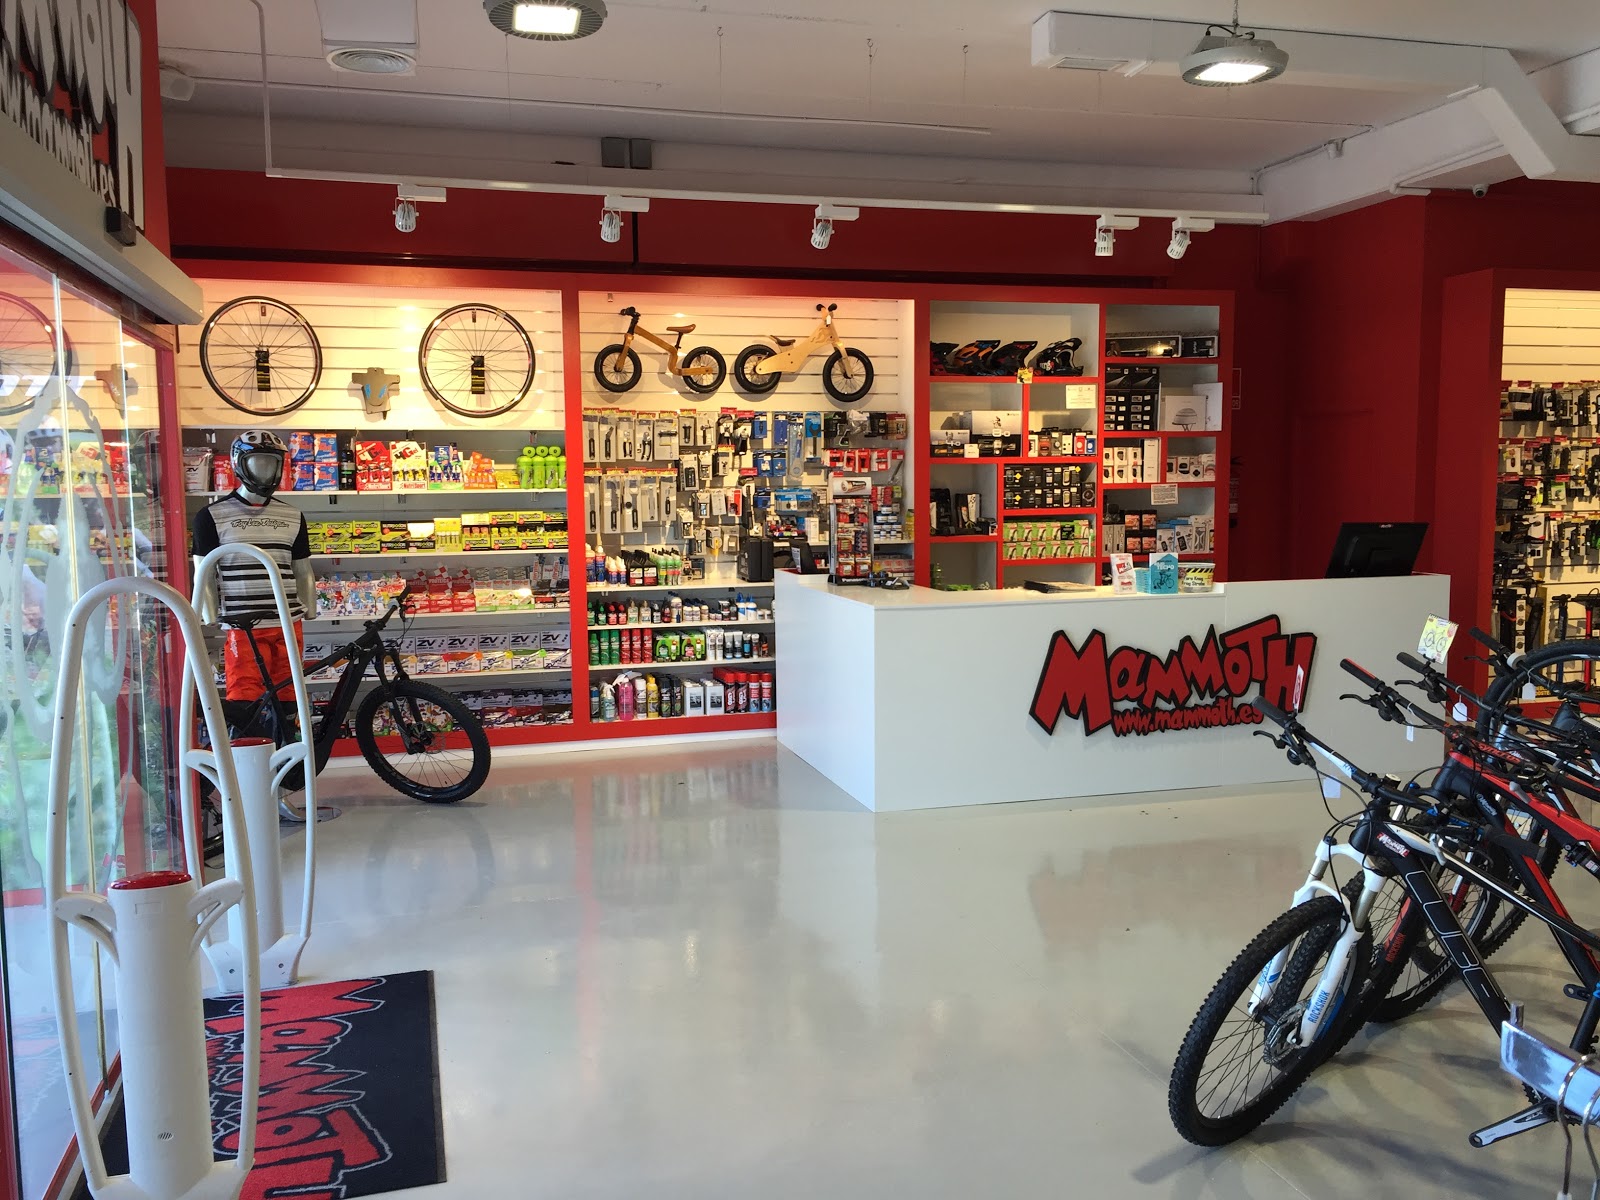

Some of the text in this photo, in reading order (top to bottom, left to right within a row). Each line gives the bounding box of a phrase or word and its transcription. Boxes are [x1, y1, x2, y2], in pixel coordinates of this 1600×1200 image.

[231, 518, 247, 530] Troy
[1112, 696, 1264, 737] www.mammoth.es
[1406, 870, 1501, 999] CUBE
[1307, 990, 1330, 1024] ROCKSHOX
